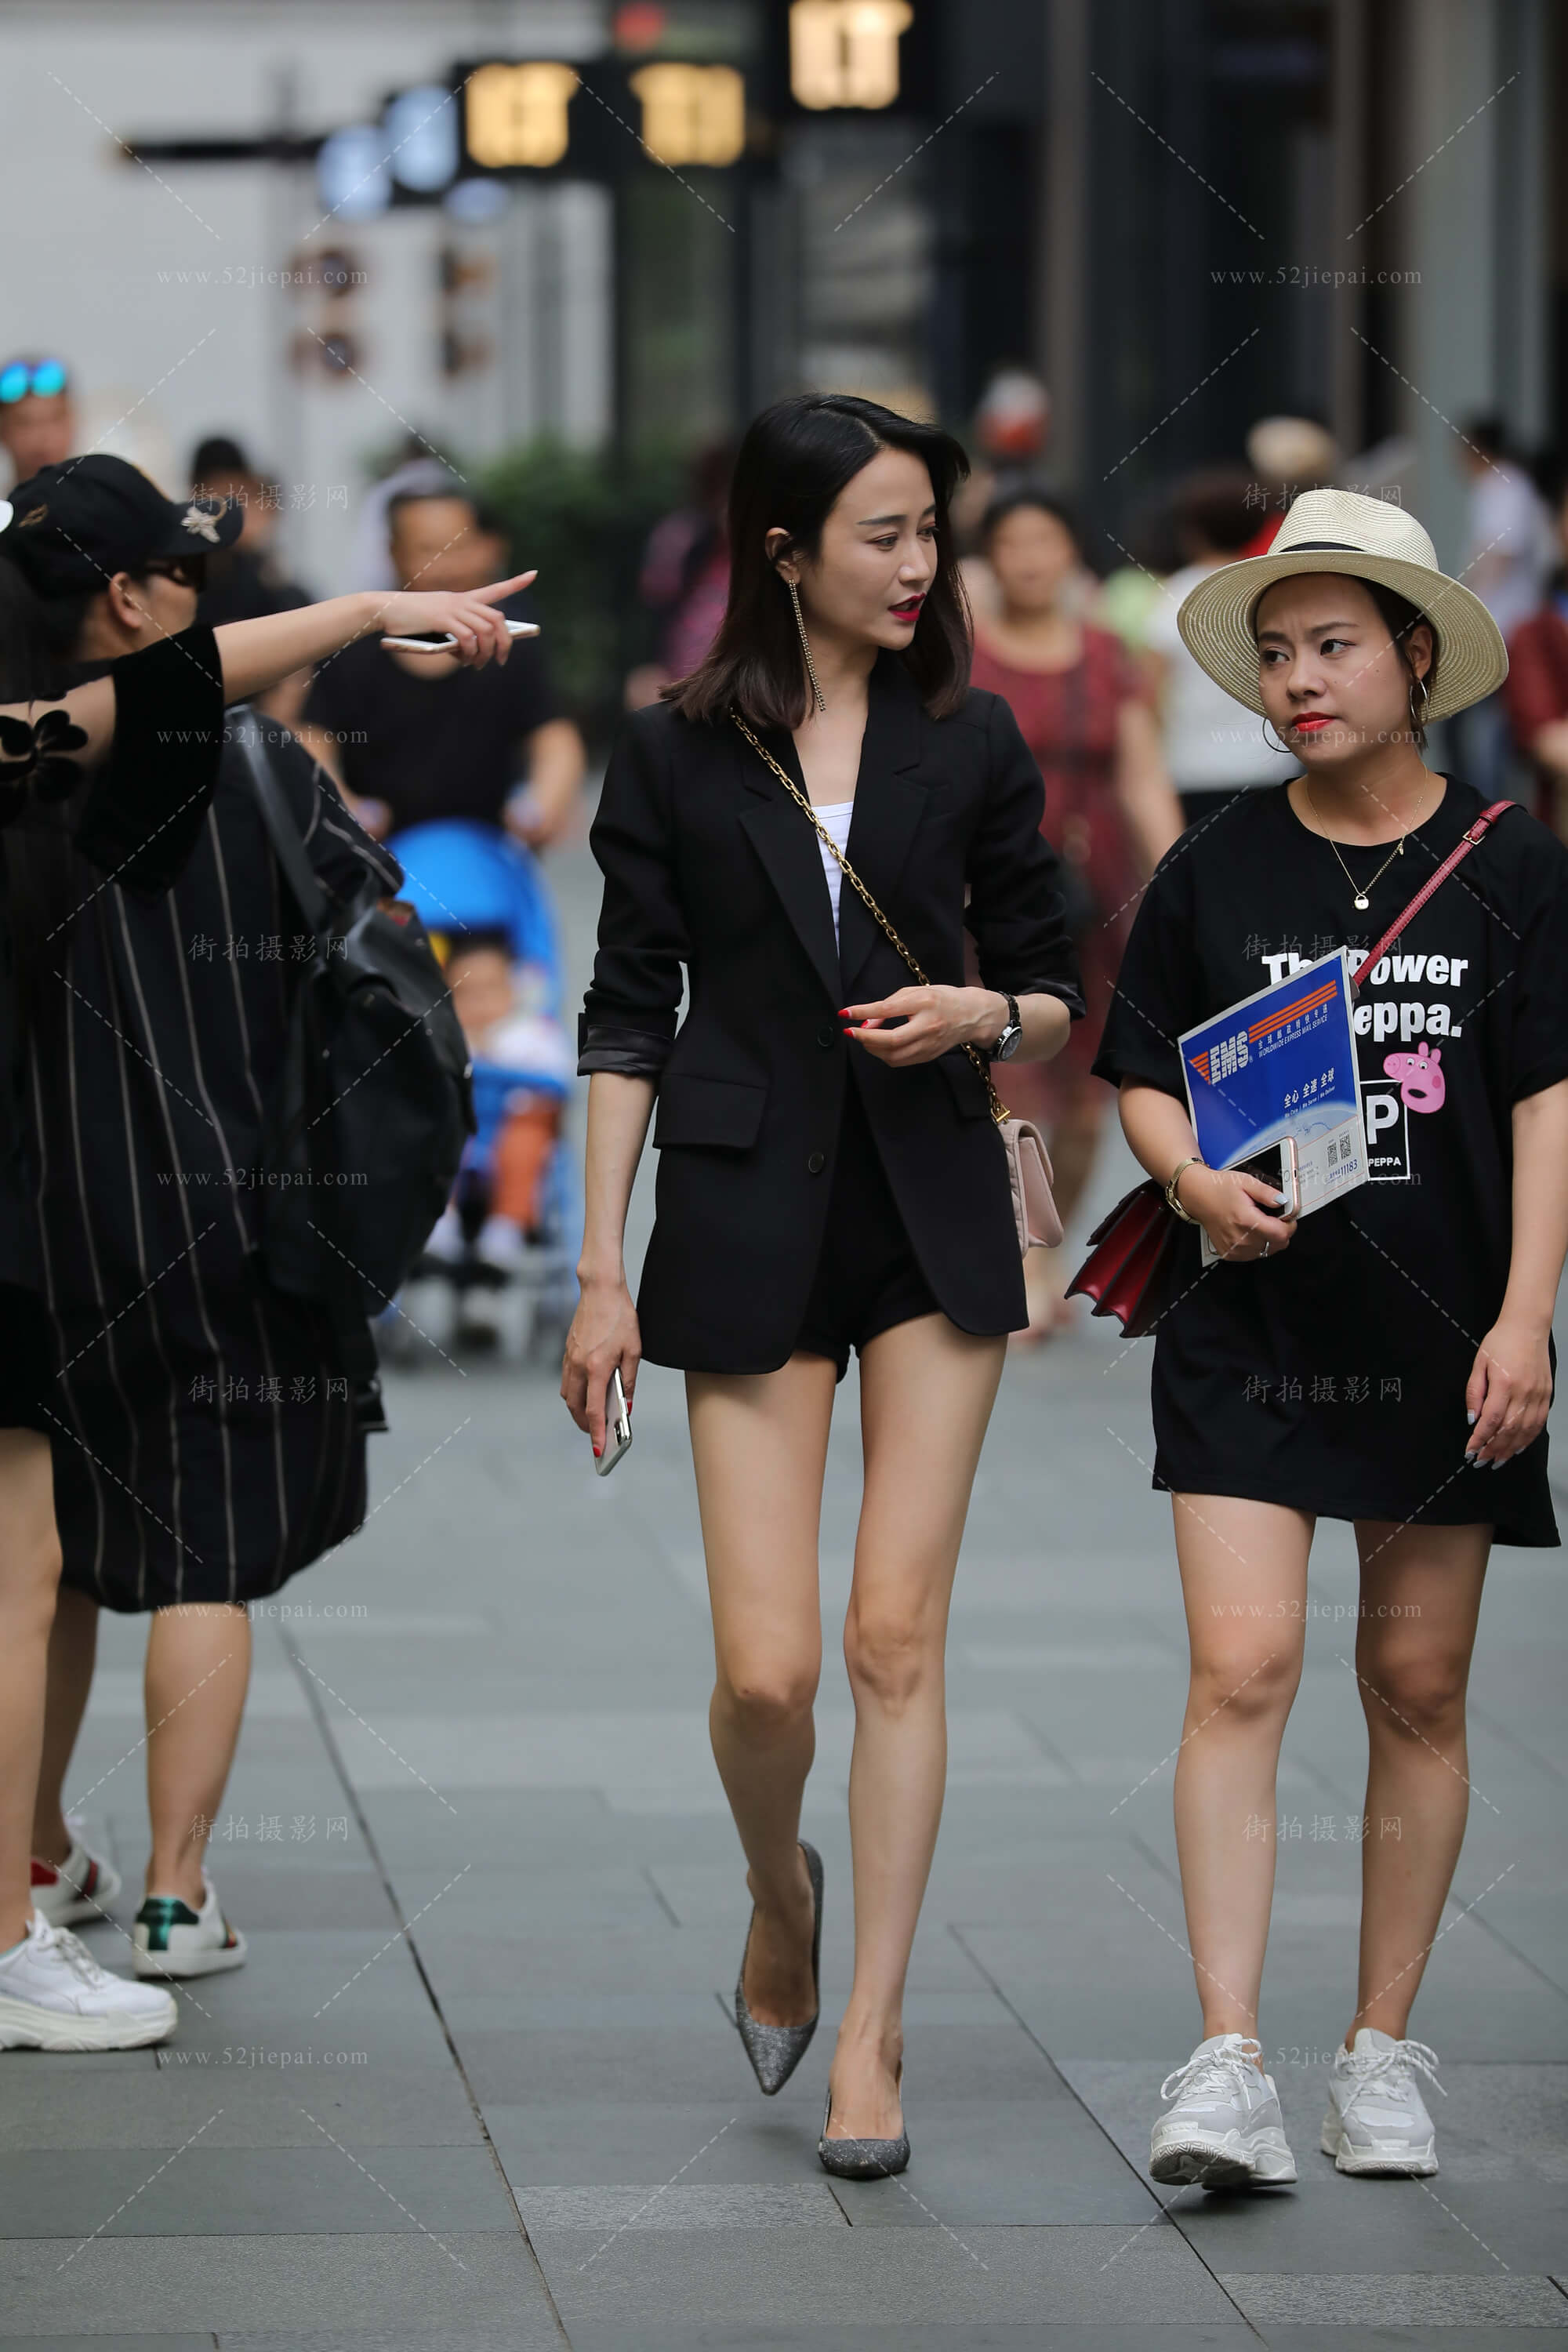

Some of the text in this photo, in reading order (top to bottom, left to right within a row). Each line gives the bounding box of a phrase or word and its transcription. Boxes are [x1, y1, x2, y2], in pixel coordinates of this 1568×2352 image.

[1261, 949, 1468, 987] Th Power
[1258, 1014, 1328, 1058] WORLDWIDE EXPRESS MAIL SERVICE
[1353, 1001, 1462, 1043] eppa.
[1209, 1030, 1249, 1085] EMS
[1283, 1067, 1334, 1109] 全心 全速 全球
[1366, 1094, 1399, 1145] P
[1340, 1159, 1359, 1176] 11183
[1367, 1156, 1402, 1167] PEPPA
